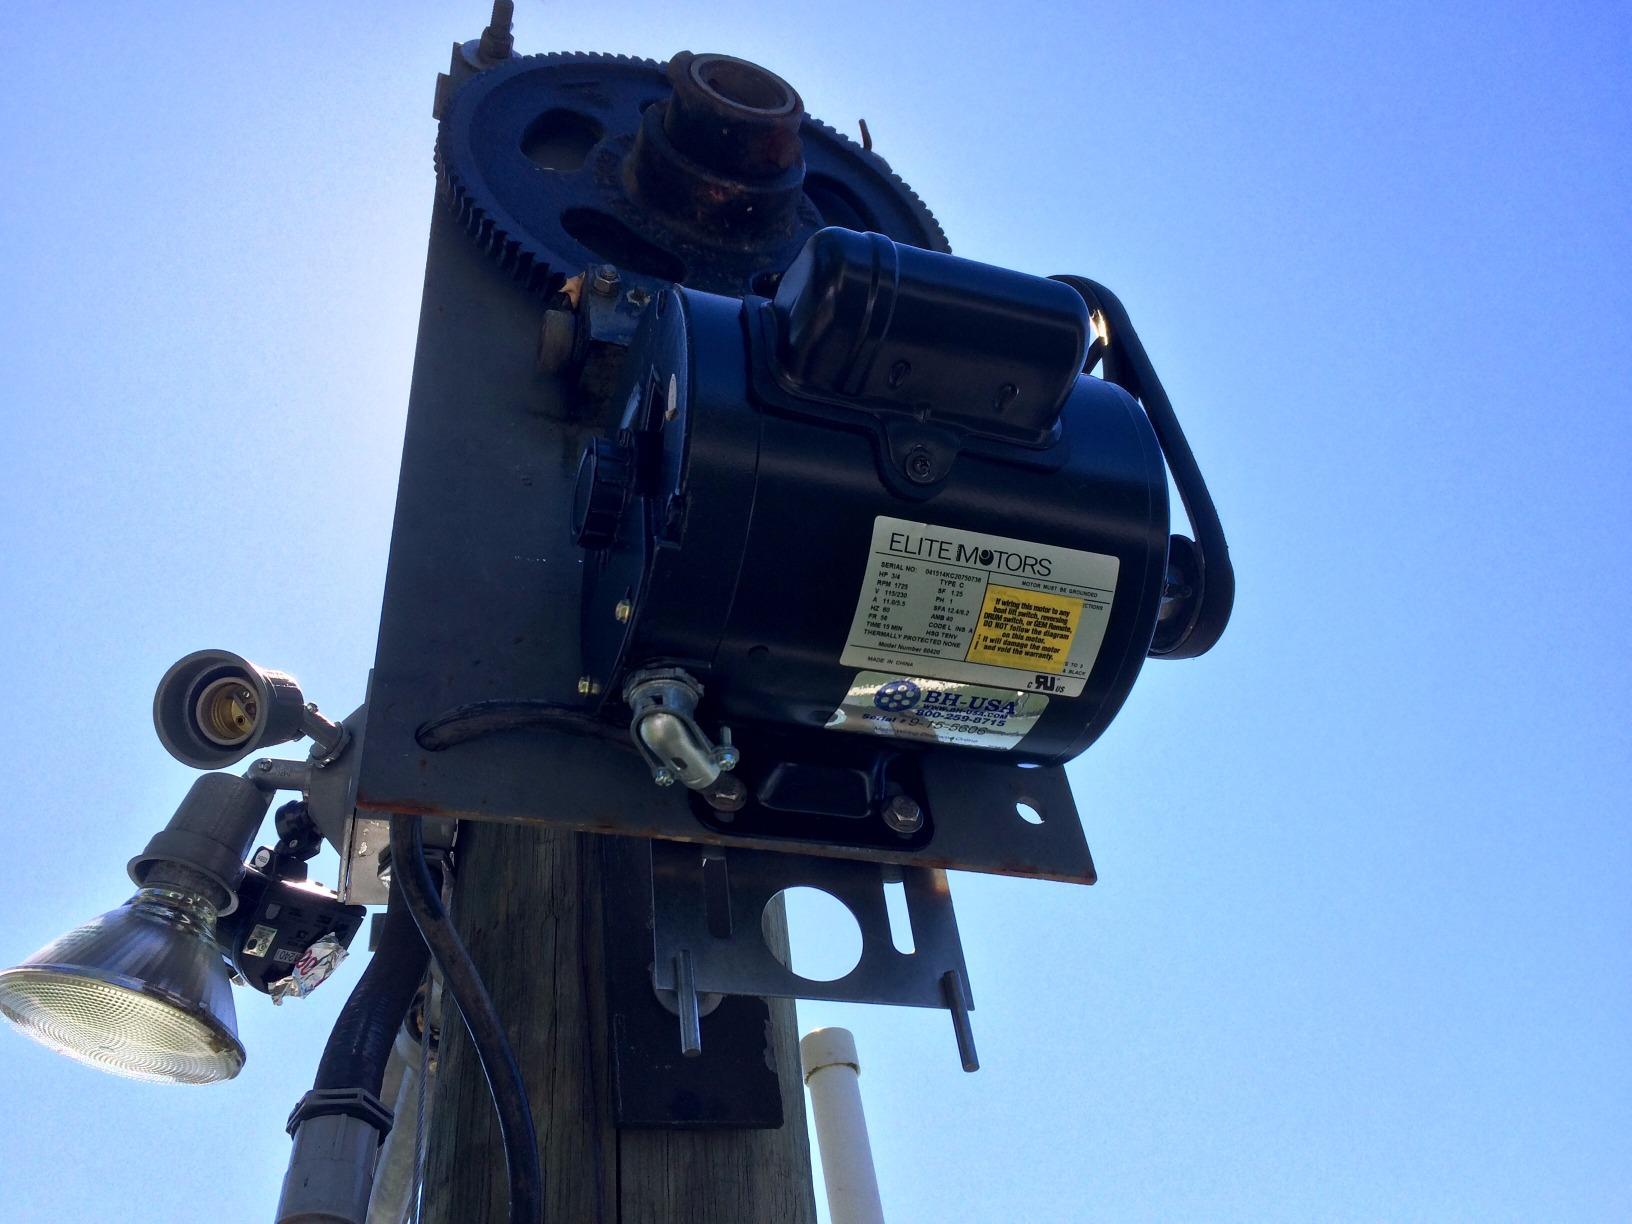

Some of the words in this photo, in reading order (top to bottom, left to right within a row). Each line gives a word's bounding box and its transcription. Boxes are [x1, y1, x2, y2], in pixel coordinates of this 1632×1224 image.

[889, 532, 953, 561] ELITE
[956, 544, 1052, 577] MOTORS
[880, 561, 904, 571] SERIAL
[879, 570, 889, 578] HP
[894, 582, 908, 590] 1725
[940, 579, 956, 588] TYPE
[1021, 580, 1041, 589] MOTOR
[1068, 588, 1098, 598] GROUNDED
[1001, 599, 1020, 610] wiring
[1021, 602, 1033, 610] this
[1033, 604, 1051, 612] motor
[1052, 607, 1058, 615] to
[1058, 609, 1071, 618] any
[984, 612, 1003, 621] DRUM
[1003, 616, 1025, 626] switch,
[1033, 620, 1048, 628] GEM
[1017, 610, 1040, 620] switch,
[1040, 614, 1069, 625] reversing
[928, 622, 946, 630] CODE
[983, 619, 993, 627] DO
[994, 621, 1008, 630] NOT
[1009, 623, 1031, 633] follow
[1031, 627, 1042, 635] the
[1043, 629, 1070, 640] diagram
[863, 629, 902, 640] THERMALLY
[903, 635, 942, 646] PROTECTED
[942, 640, 961, 648] NONE
[942, 631, 958, 640] TENV
[1011, 633, 1025, 641] this
[1025, 635, 1045, 644] motor.
[897, 643, 922, 653] Number
[997, 645, 1011, 653] void
[1024, 650, 1054, 661] warranty.
[1003, 639, 1028, 649] damage
[1029, 642, 1040, 650] the
[1041, 645, 1061, 654] motor
[867, 656, 884, 664] MADE
[922, 690, 1017, 715] BH-USA
[915, 709, 1008, 727] 800-259-8715
